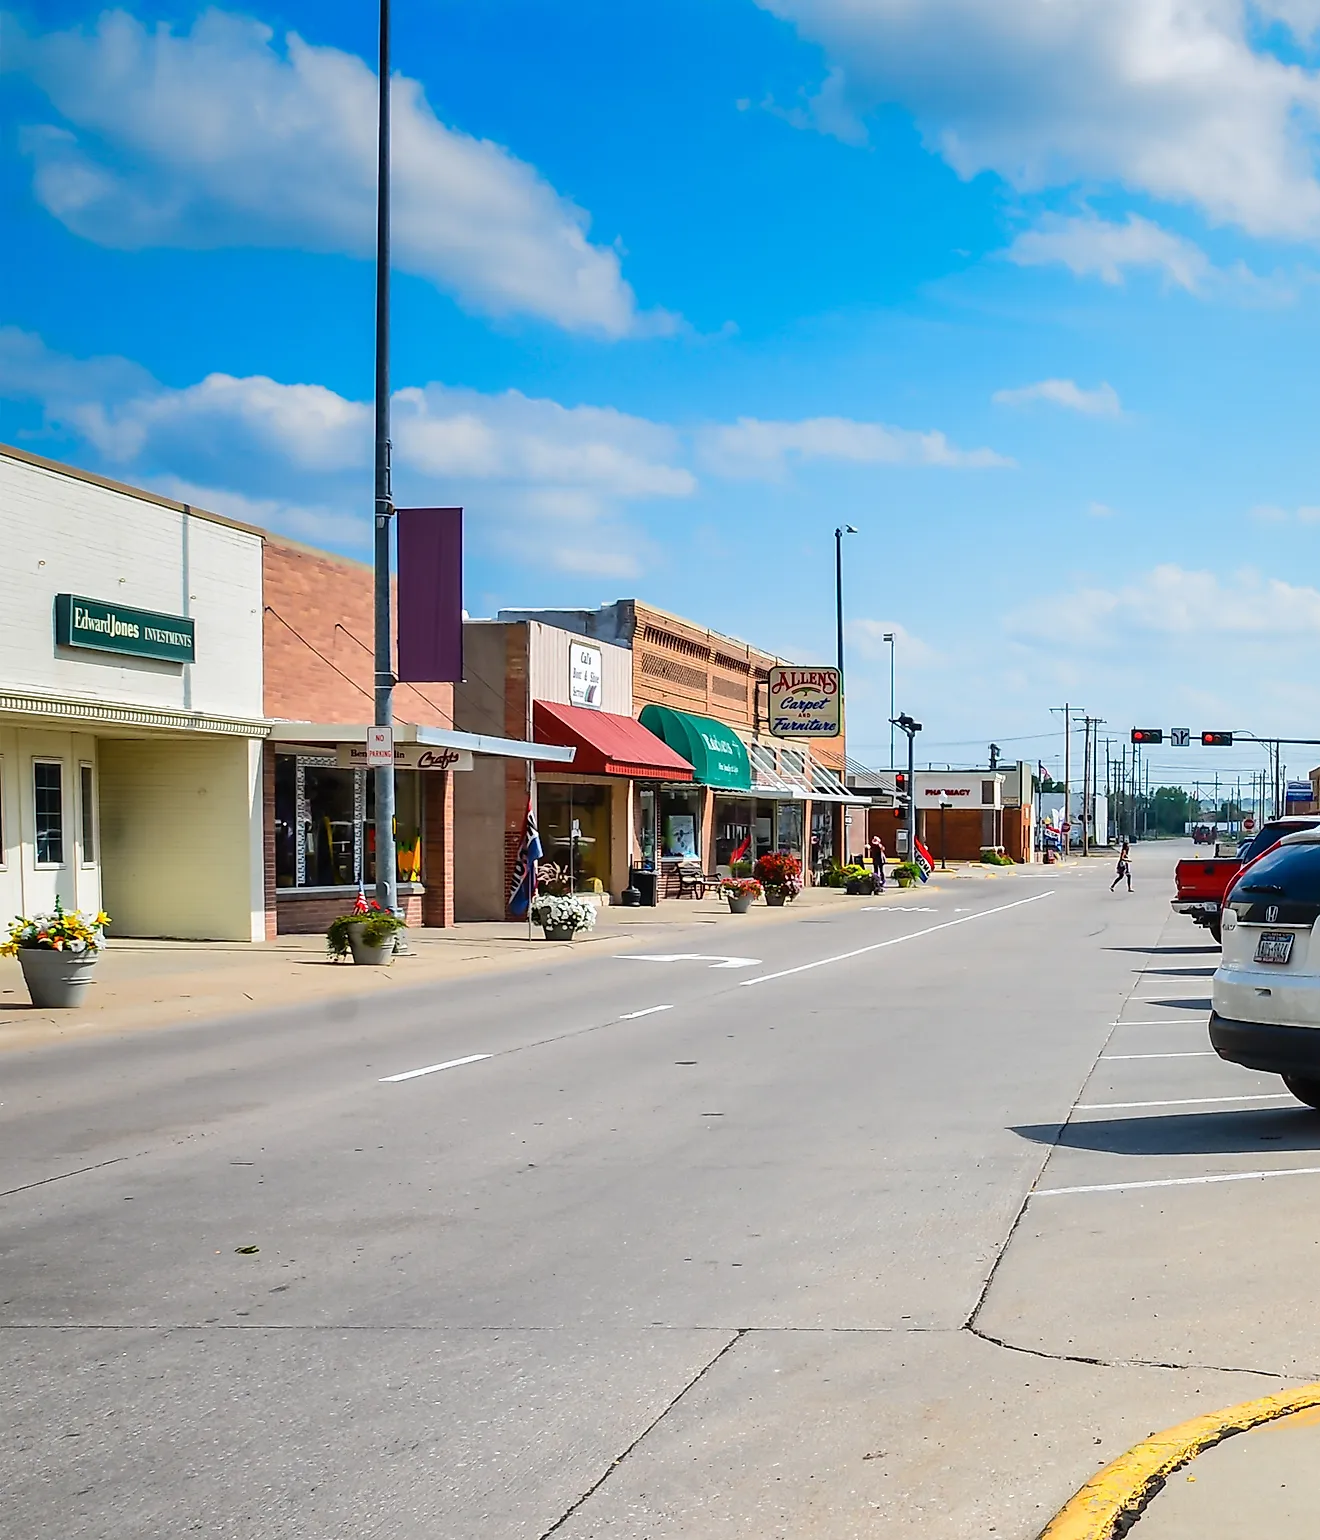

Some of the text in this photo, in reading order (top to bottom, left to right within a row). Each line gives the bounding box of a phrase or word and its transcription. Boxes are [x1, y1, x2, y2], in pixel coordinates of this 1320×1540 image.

[144, 626, 192, 648] INVESTMENTS
[771, 671, 837, 695] ALLEN'S
[780, 696, 831, 713] Carpet
[772, 717, 836, 731] Furniture
[375, 734, 385, 742] NO
[369, 750, 392, 758] PARKING
[417, 748, 459, 769] Crafts
